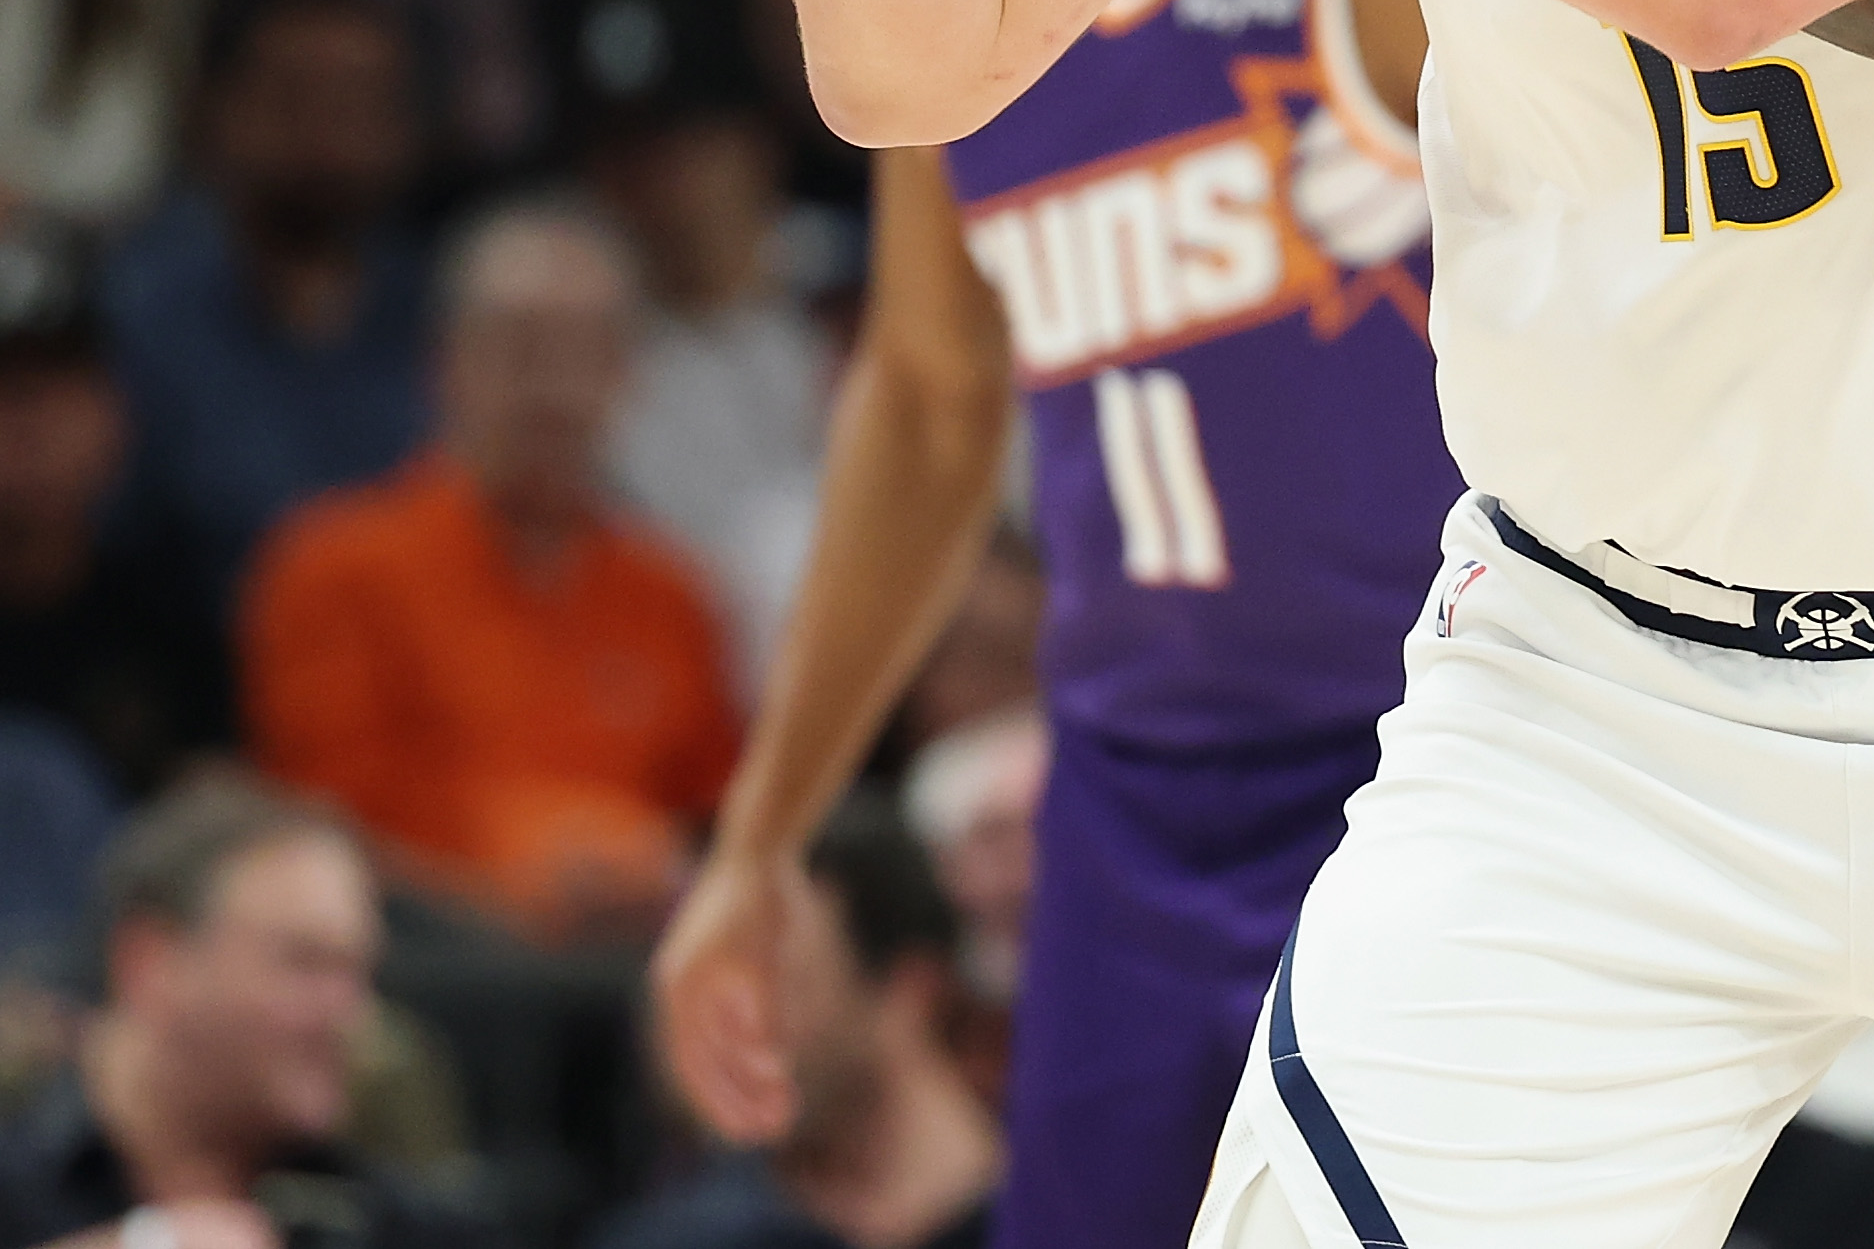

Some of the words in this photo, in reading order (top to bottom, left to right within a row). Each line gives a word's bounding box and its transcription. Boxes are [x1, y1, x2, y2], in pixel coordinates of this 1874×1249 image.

[1600, 22, 1842, 243] 15
[965, 138, 1284, 372] UNS
[1092, 364, 1232, 592] 11
